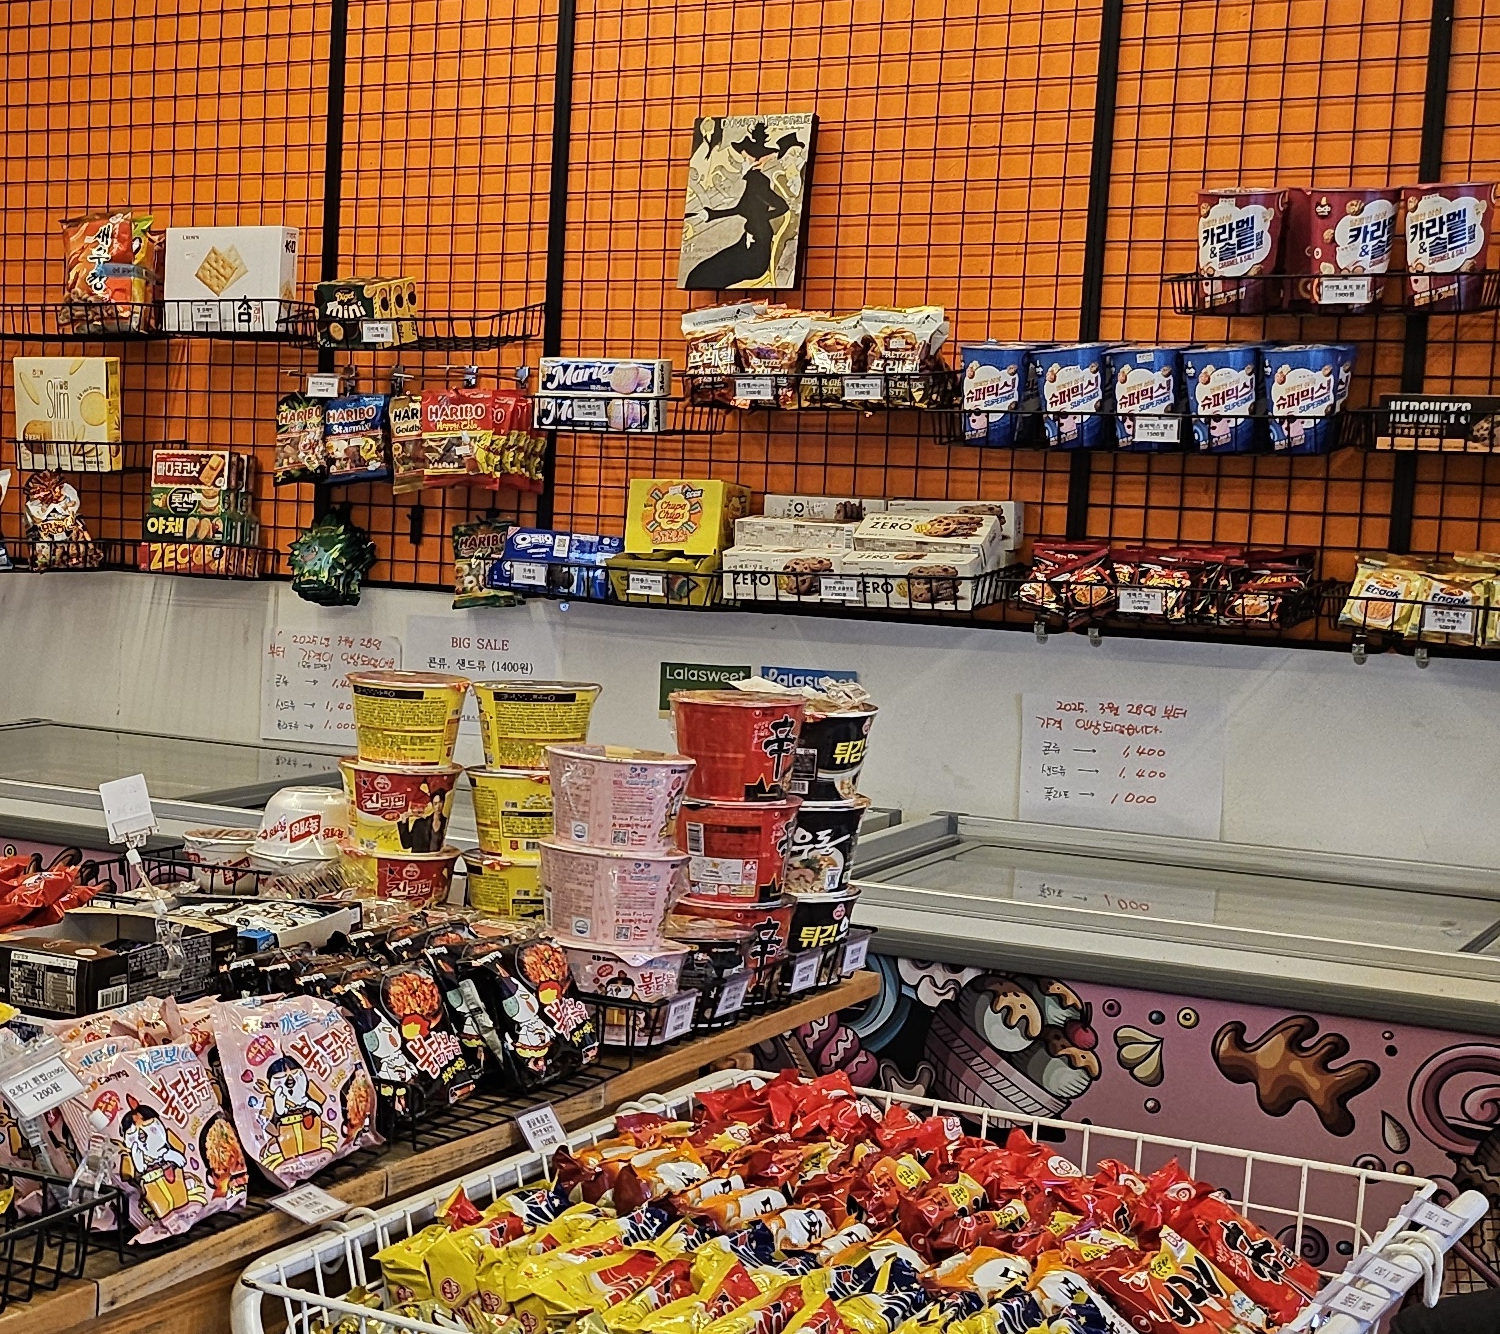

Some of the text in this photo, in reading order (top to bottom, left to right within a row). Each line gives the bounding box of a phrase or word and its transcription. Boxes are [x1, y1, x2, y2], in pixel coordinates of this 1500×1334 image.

[1202, 214, 1256, 248] 카라멜
[1409, 207, 1467, 244] 카라멜
[1218, 233, 1257, 262] 솔트
[1428, 230, 1468, 261] 솔트
[326, 301, 366, 318] mini
[546, 362, 610, 389] Marie
[46, 378, 70, 419] Slim
[278, 406, 322, 425] HARIBO
[326, 405, 377, 425] HARIBO
[393, 410, 422, 422] HAR
[427, 403, 485, 422] HARIBO
[332, 423, 371, 435] Starmix
[658, 509, 687, 522] Chups
[661, 500, 688, 513] Chupa
[147, 516, 183, 535] 야채
[869, 521, 913, 533] ZERO
[514, 533, 554, 551] 오레오
[733, 573, 771, 587] ZERO
[1366, 583, 1401, 599] Enaak
[450, 636, 510, 652] BIG SALE
[456, 657, 487, 673] 샌드류
[491, 660, 535, 676] (1400원)
[665, 665, 747, 683] Lalasweet
[325, 700, 352, 713] 1,40
[1055, 700, 1188, 720] 2025. 3월 28일 부터
[1036, 716, 1063, 732] 가격
[762, 713, 798, 783] 辛
[361, 792, 407, 811] 진라면
[789, 828, 851, 859] 우동
[386, 880, 431, 897] 진라면
[8, 1079, 34, 1098] 오뚜기
[31, 1083, 63, 1103] 1200원
